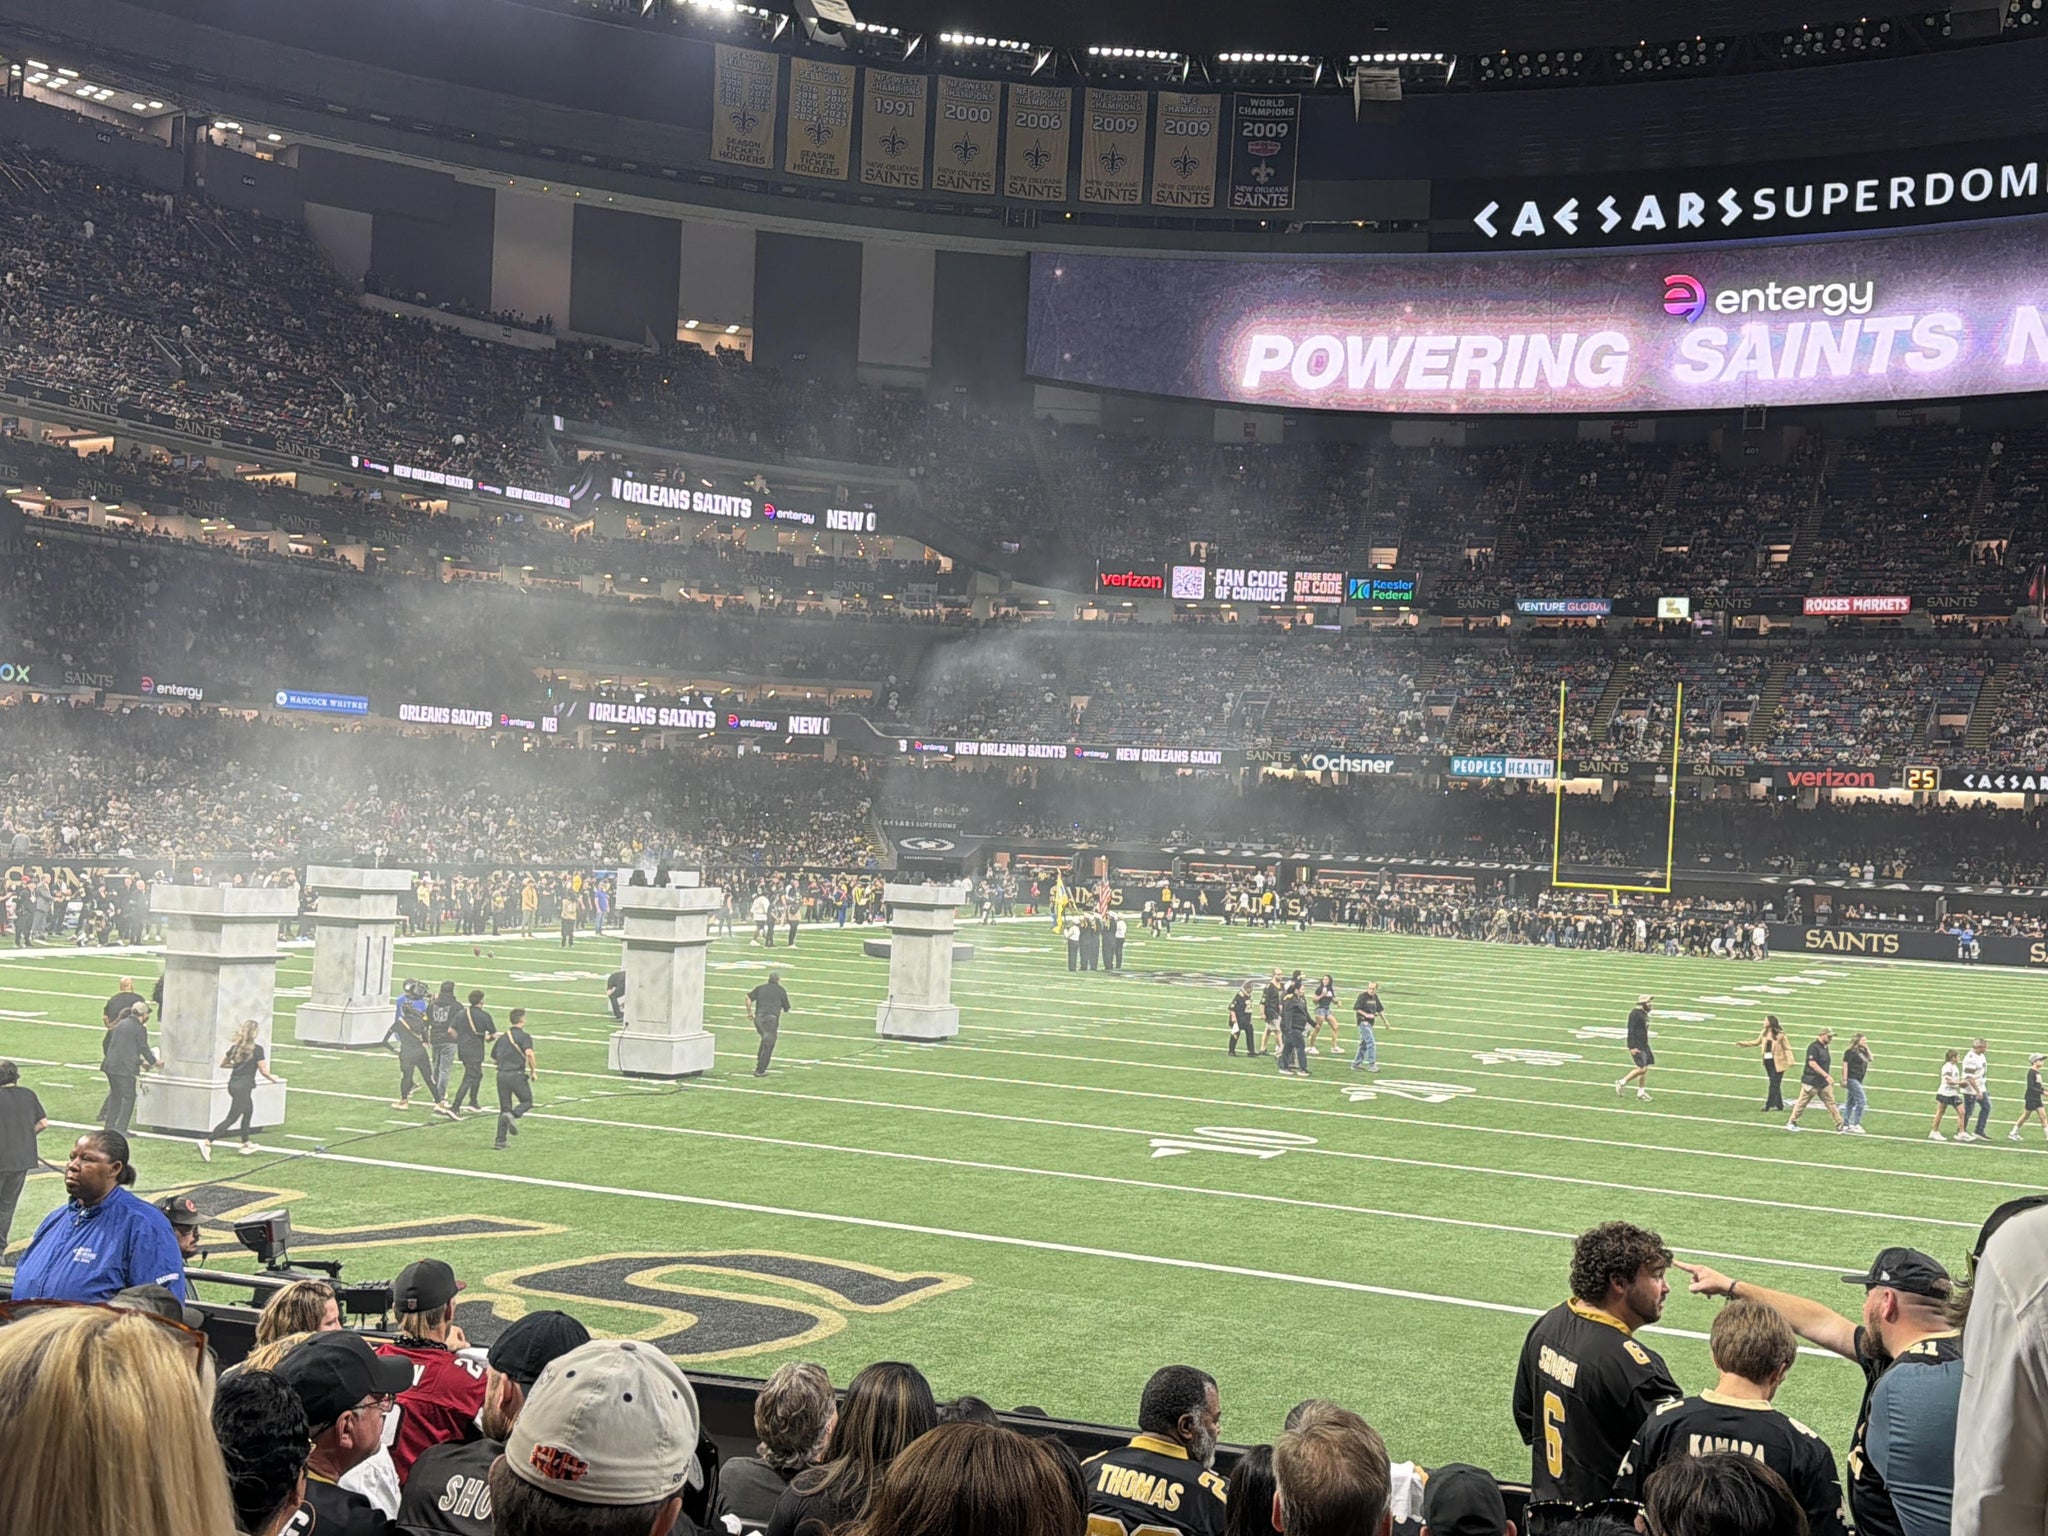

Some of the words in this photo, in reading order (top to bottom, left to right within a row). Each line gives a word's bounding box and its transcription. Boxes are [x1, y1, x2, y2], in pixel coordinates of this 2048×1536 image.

[875, 96, 914, 118] 1991
[1014, 96, 1066, 108] CHAMPIONS
[1090, 101, 1143, 112] CHAMPIONS
[1162, 104, 1215, 115] CHAMPIONS
[1250, 99, 1285, 108] WORLD
[944, 103, 992, 124] 2000
[1015, 111, 1062, 130] 2006
[1238, 106, 1295, 119] CHAMPIONS
[1091, 114, 1139, 134] 2009
[1163, 119, 1211, 138] 2009
[1242, 122, 1289, 139] 2009
[726, 144, 759, 155] TICKET
[727, 137, 760, 149] SEASON
[720, 151, 765, 164] HOLDERS
[800, 150, 836, 161] SEASON
[800, 158, 834, 168] TICKET
[793, 162, 841, 176] HOLDERS
[864, 168, 919, 187] SAINTS
[937, 173, 991, 192] SAINTS
[1009, 182, 1062, 199] SAINTS
[1084, 186, 1139, 202] SAINTS
[1156, 191, 1210, 206] SAINTS
[1234, 193, 1289, 208] SAINTS
[1474, 194, 1741, 238] CAESARS
[1752, 162, 2048, 221] SUPERDOM
[1714, 279, 1875, 315] entergy
[1243, 331, 1631, 392] POWERING
[1675, 312, 1964, 383] SAINTS
[69, 396, 119, 418] SAINTS
[174, 418, 222, 440] SAINTS
[275, 440, 321, 461] SAINTS
[411, 467, 444, 485] ORLEANS
[445, 475, 473, 489] SAINTS
[77, 477, 122, 497] SAINTS
[523, 489, 554, 504] ORLEANS
[622, 479, 690, 510] ORLEANS
[692, 491, 752, 518] SAINTS
[183, 498, 228, 513] SAINTS
[279, 512, 322, 530] SAINTS
[775, 509, 815, 525] entergy
[826, 509, 861, 530] NEW
[374, 529, 414, 545] SAINTS
[1101, 570, 1164, 590] verizon
[1214, 569, 1243, 587] FAN
[1247, 570, 1288, 588] CODE
[1294, 571, 1318, 581] PLEASE
[1320, 572, 1343, 581] SCAN
[1372, 578, 1414, 590] Keesler
[832, 580, 875, 592] SAINTS
[1214, 584, 1230, 601] OF
[1231, 584, 1288, 603] CONDUCT
[1293, 580, 1309, 594] QR
[1311, 581, 1343, 595] CODE
[1372, 589, 1412, 601] Federal
[1926, 596, 1977, 607] SAINTS
[1457, 598, 1500, 609] SAINTS
[1517, 602, 1566, 612] VENTURE
[1567, 602, 1610, 612] GLOBAL
[1703, 598, 1752, 609] SAINTS
[1804, 599, 1849, 611] ROUSES
[1852, 599, 1908, 612] MARKETS
[64, 671, 114, 687] SAINTS
[156, 682, 203, 700] entergy
[290, 695, 327, 706] HANCOCK
[329, 698, 368, 711] WHITNEY
[399, 703, 450, 724] ORLEANS
[450, 708, 493, 728] SAINTS
[596, 702, 656, 723] ORLEANS
[658, 708, 717, 729] SAINTS
[740, 718, 777, 731] entergy
[788, 715, 818, 735] NEW
[955, 741, 977, 755] NEW
[979, 742, 1026, 758] ORLEANS
[1027, 744, 1067, 759] SAINTS
[1115, 748, 1138, 761] NEW
[1140, 749, 1188, 763] ORLEANS
[1245, 750, 1291, 761] SAINTS
[1311, 753, 1394, 773] Ochsner
[1453, 760, 1503, 774] PEOPLES
[1506, 760, 1552, 775] HEALTH
[1578, 760, 1630, 773] SAINTS
[1692, 764, 1745, 776] SAINTS
[1786, 768, 1875, 787] verizon
[1908, 769, 1936, 789] 25
[918, 821, 957, 829] SUPERDOME
[1806, 929, 1900, 954] SAINTS
[1543, 1390, 1566, 1479] 6
[1096, 1463, 1184, 1511] THOMAS
